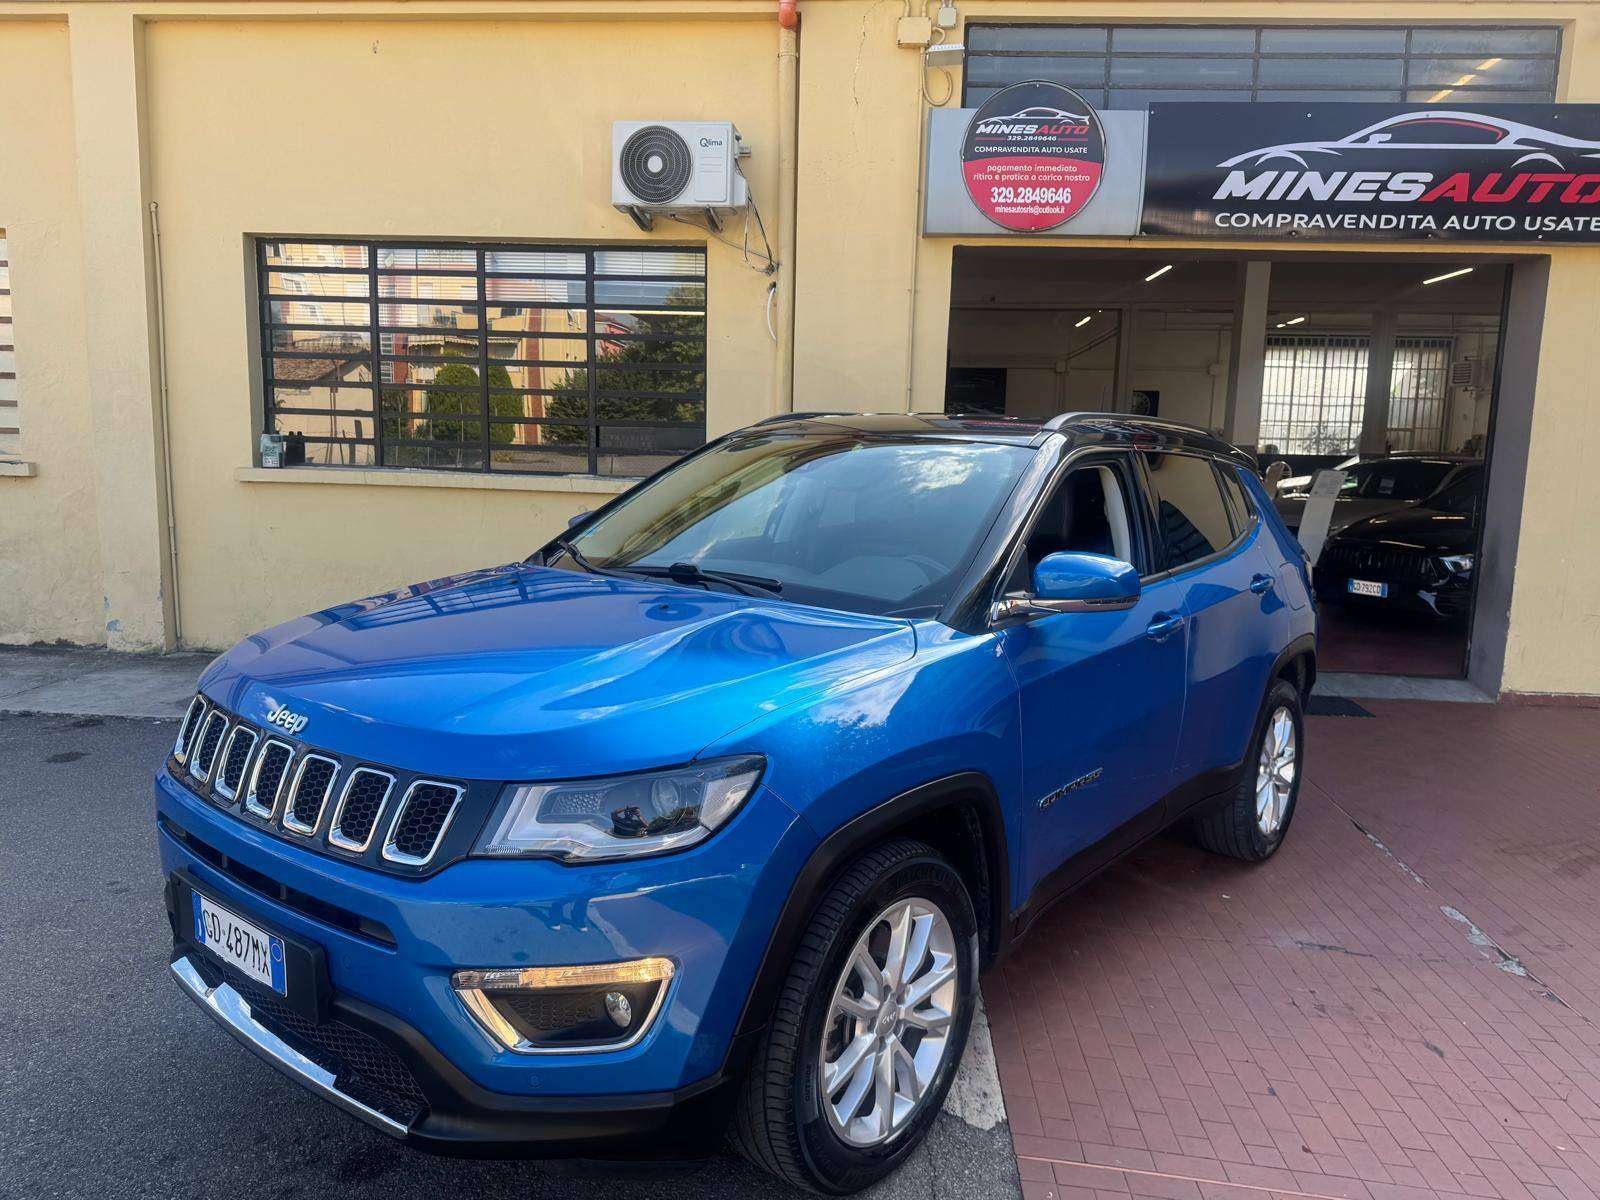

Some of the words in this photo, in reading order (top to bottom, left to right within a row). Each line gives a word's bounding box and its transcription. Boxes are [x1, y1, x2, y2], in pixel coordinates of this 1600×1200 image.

[976, 124, 1089, 134] MINESAUTO
[700, 137, 723, 148] Qlima
[987, 165, 1032, 173] pagamento
[1034, 164, 1078, 172] immediato
[973, 172, 993, 180] ritiro
[1001, 173, 1029, 181] pratica
[1038, 173, 1063, 181] carico
[1064, 173, 1090, 181] nostro
[990, 186, 1072, 204] 329.2849646
[1214, 212, 1437, 230] COMPRAVENDITA
[1442, 214, 1516, 231] AUTO
[1523, 215, 1600, 232] USATE
[266, 703, 309, 735] Jeep
